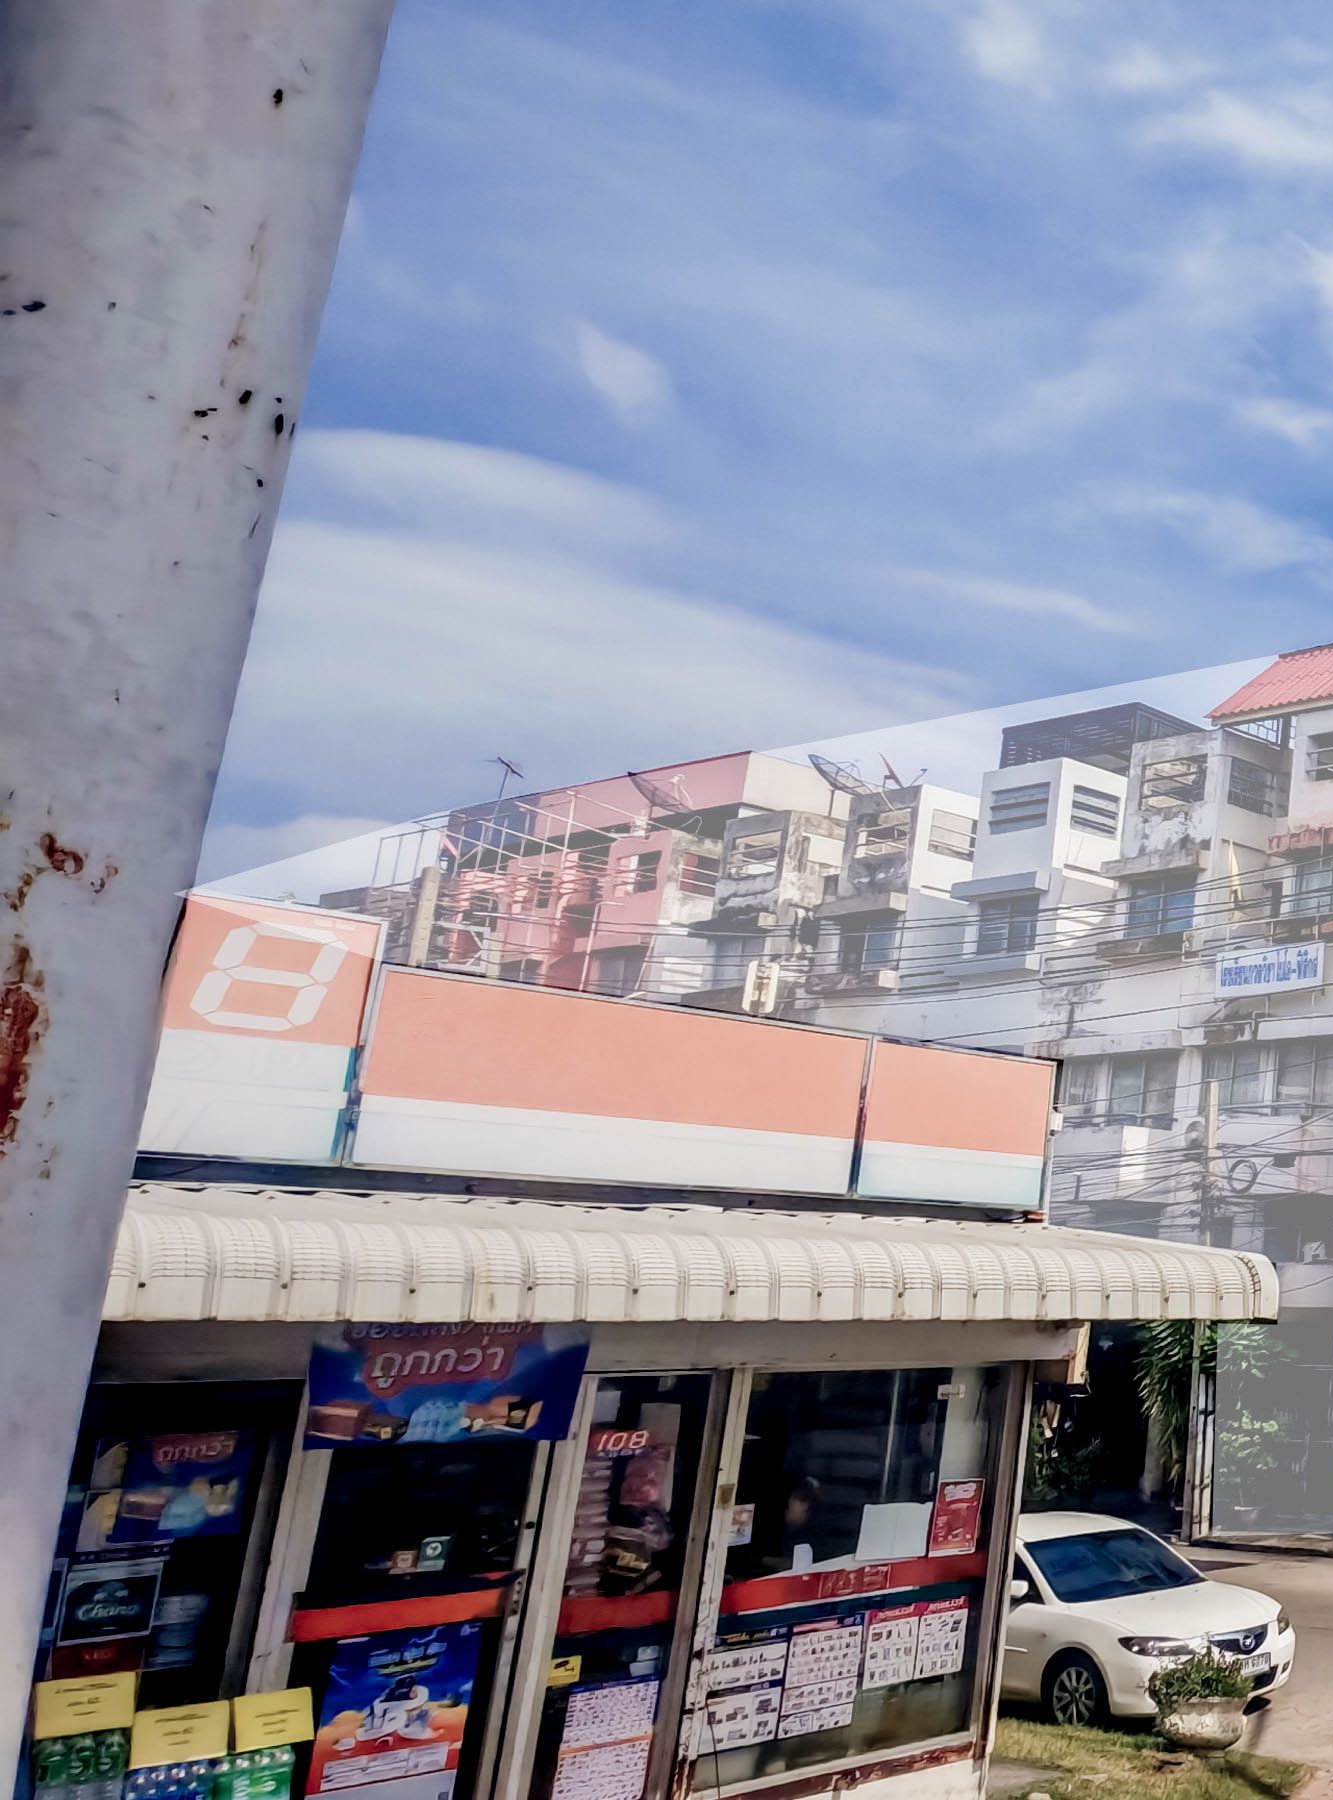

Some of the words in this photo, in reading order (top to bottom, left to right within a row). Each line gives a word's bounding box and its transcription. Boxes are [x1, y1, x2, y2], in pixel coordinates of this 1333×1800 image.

[371, 1336, 505, 1388] ถูกกว่า
[597, 1430, 650, 1451] 108
